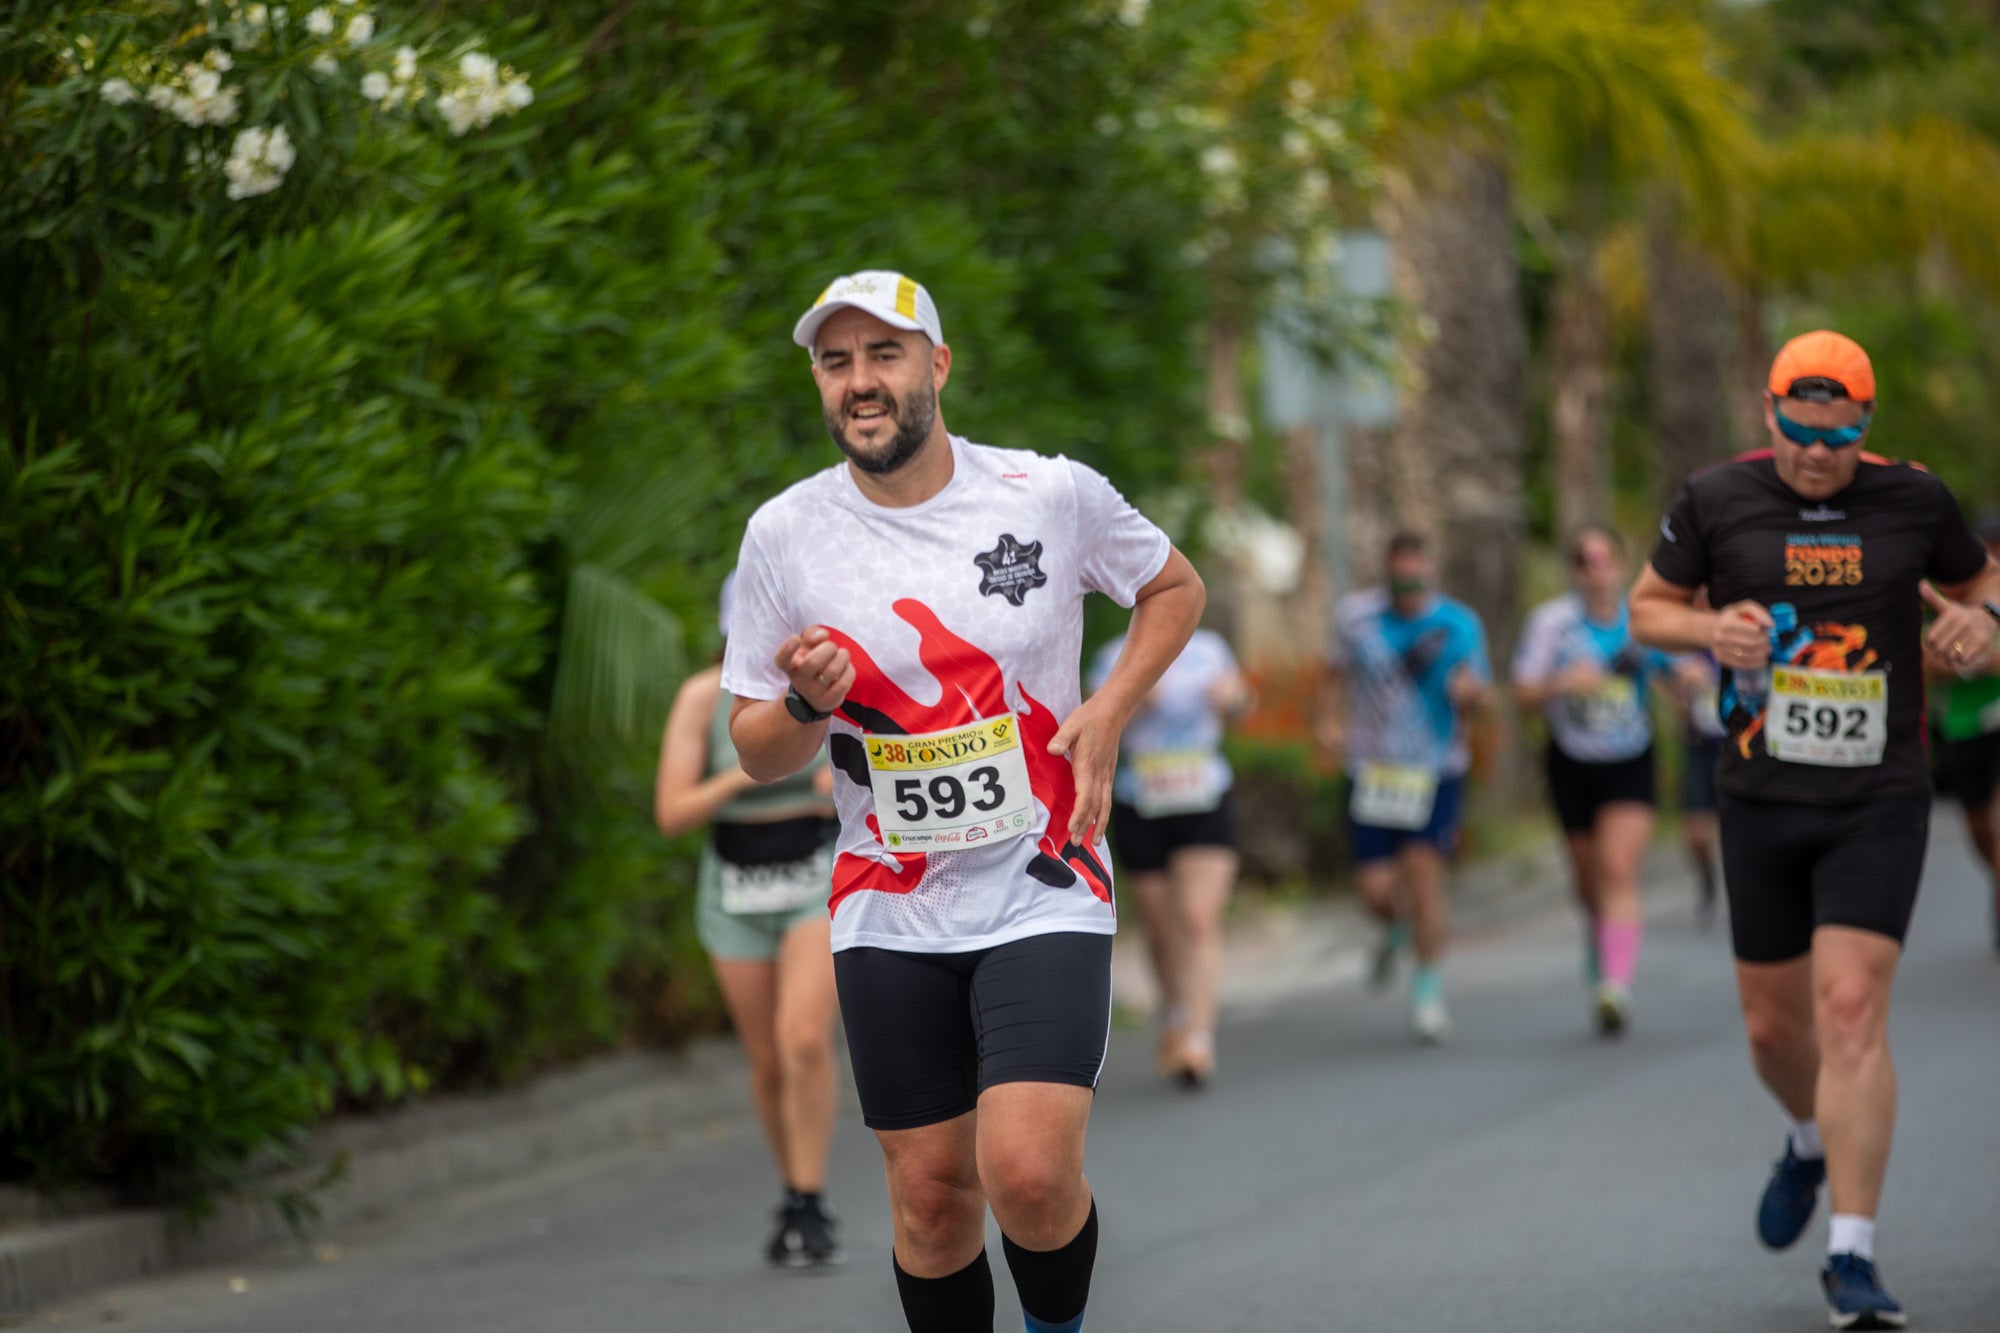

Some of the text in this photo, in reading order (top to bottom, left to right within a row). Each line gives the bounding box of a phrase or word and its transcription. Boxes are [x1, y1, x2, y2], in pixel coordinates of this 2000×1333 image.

[1785, 545, 1863, 562] FONDO
[1784, 561, 1863, 586] 2025
[1785, 702, 1868, 741] 592
[906, 737, 987, 764] FONDO
[908, 740, 936, 750] GRAN
[938, 730, 977, 745] PREMIO
[883, 743, 906, 763] 38
[895, 766, 1006, 822] 593
